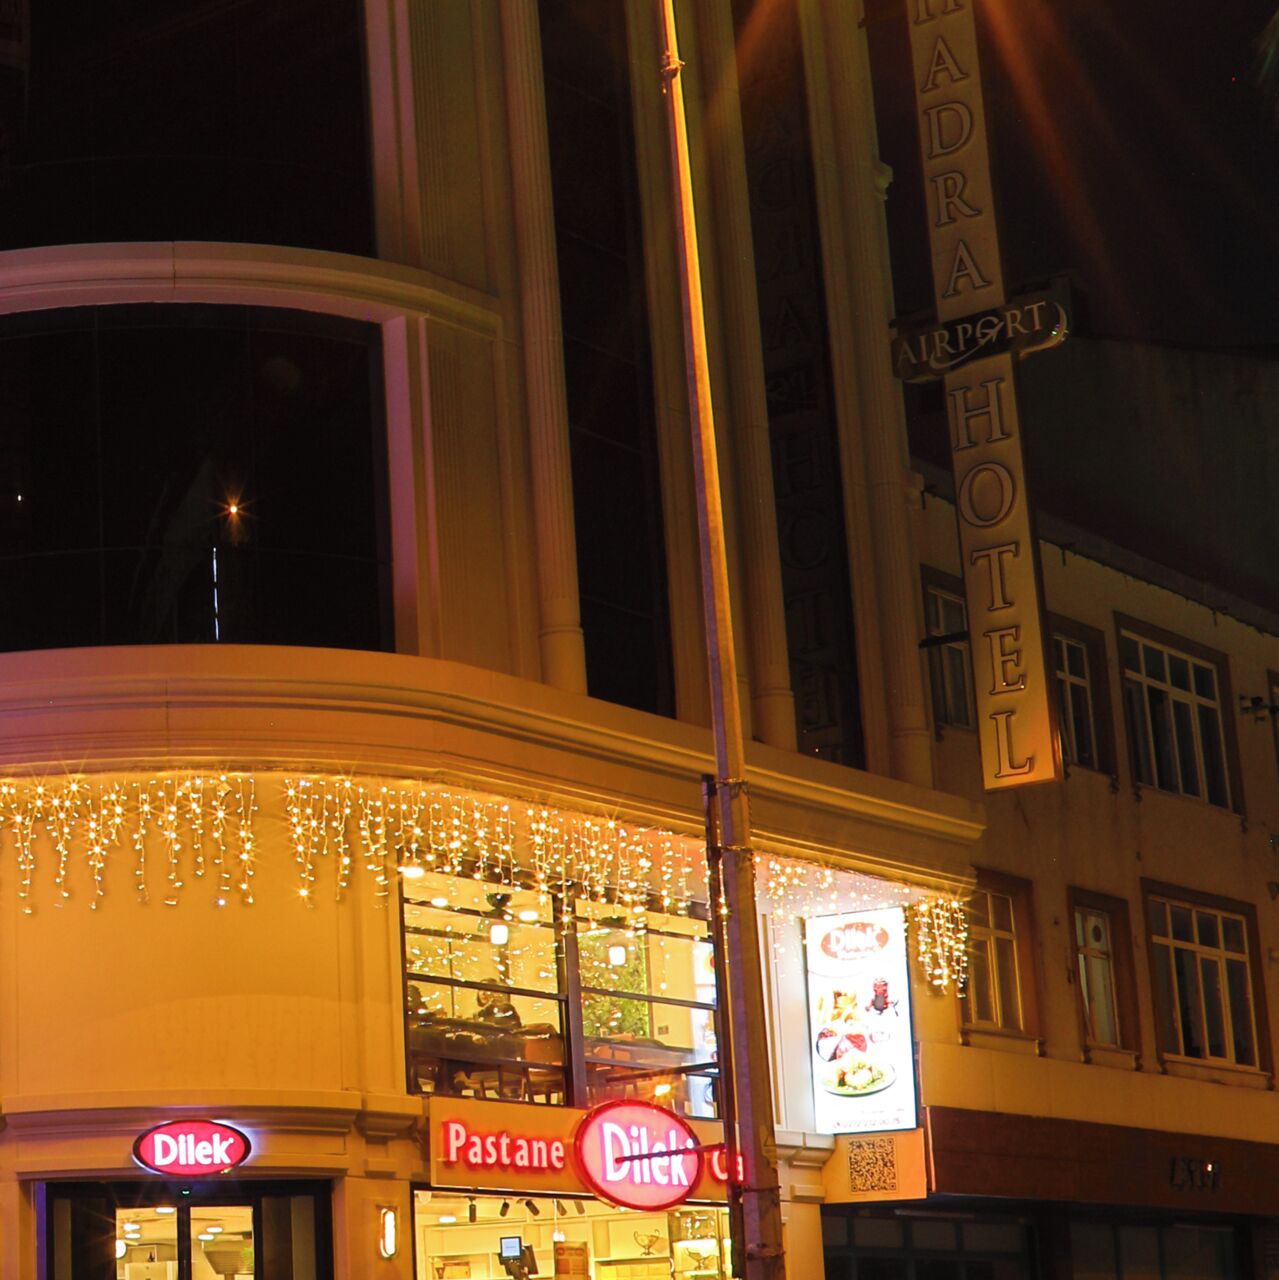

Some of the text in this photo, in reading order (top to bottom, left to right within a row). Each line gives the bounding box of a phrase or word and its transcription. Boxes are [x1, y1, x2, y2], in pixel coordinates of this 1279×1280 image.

[897, 300, 1047, 368] AIRPORT
[949, 377, 1033, 778] HOTEL
[153, 1133, 234, 1166] Dilek
[448, 1122, 565, 1169] Pastane
[602, 1122, 694, 1187] Dilek
